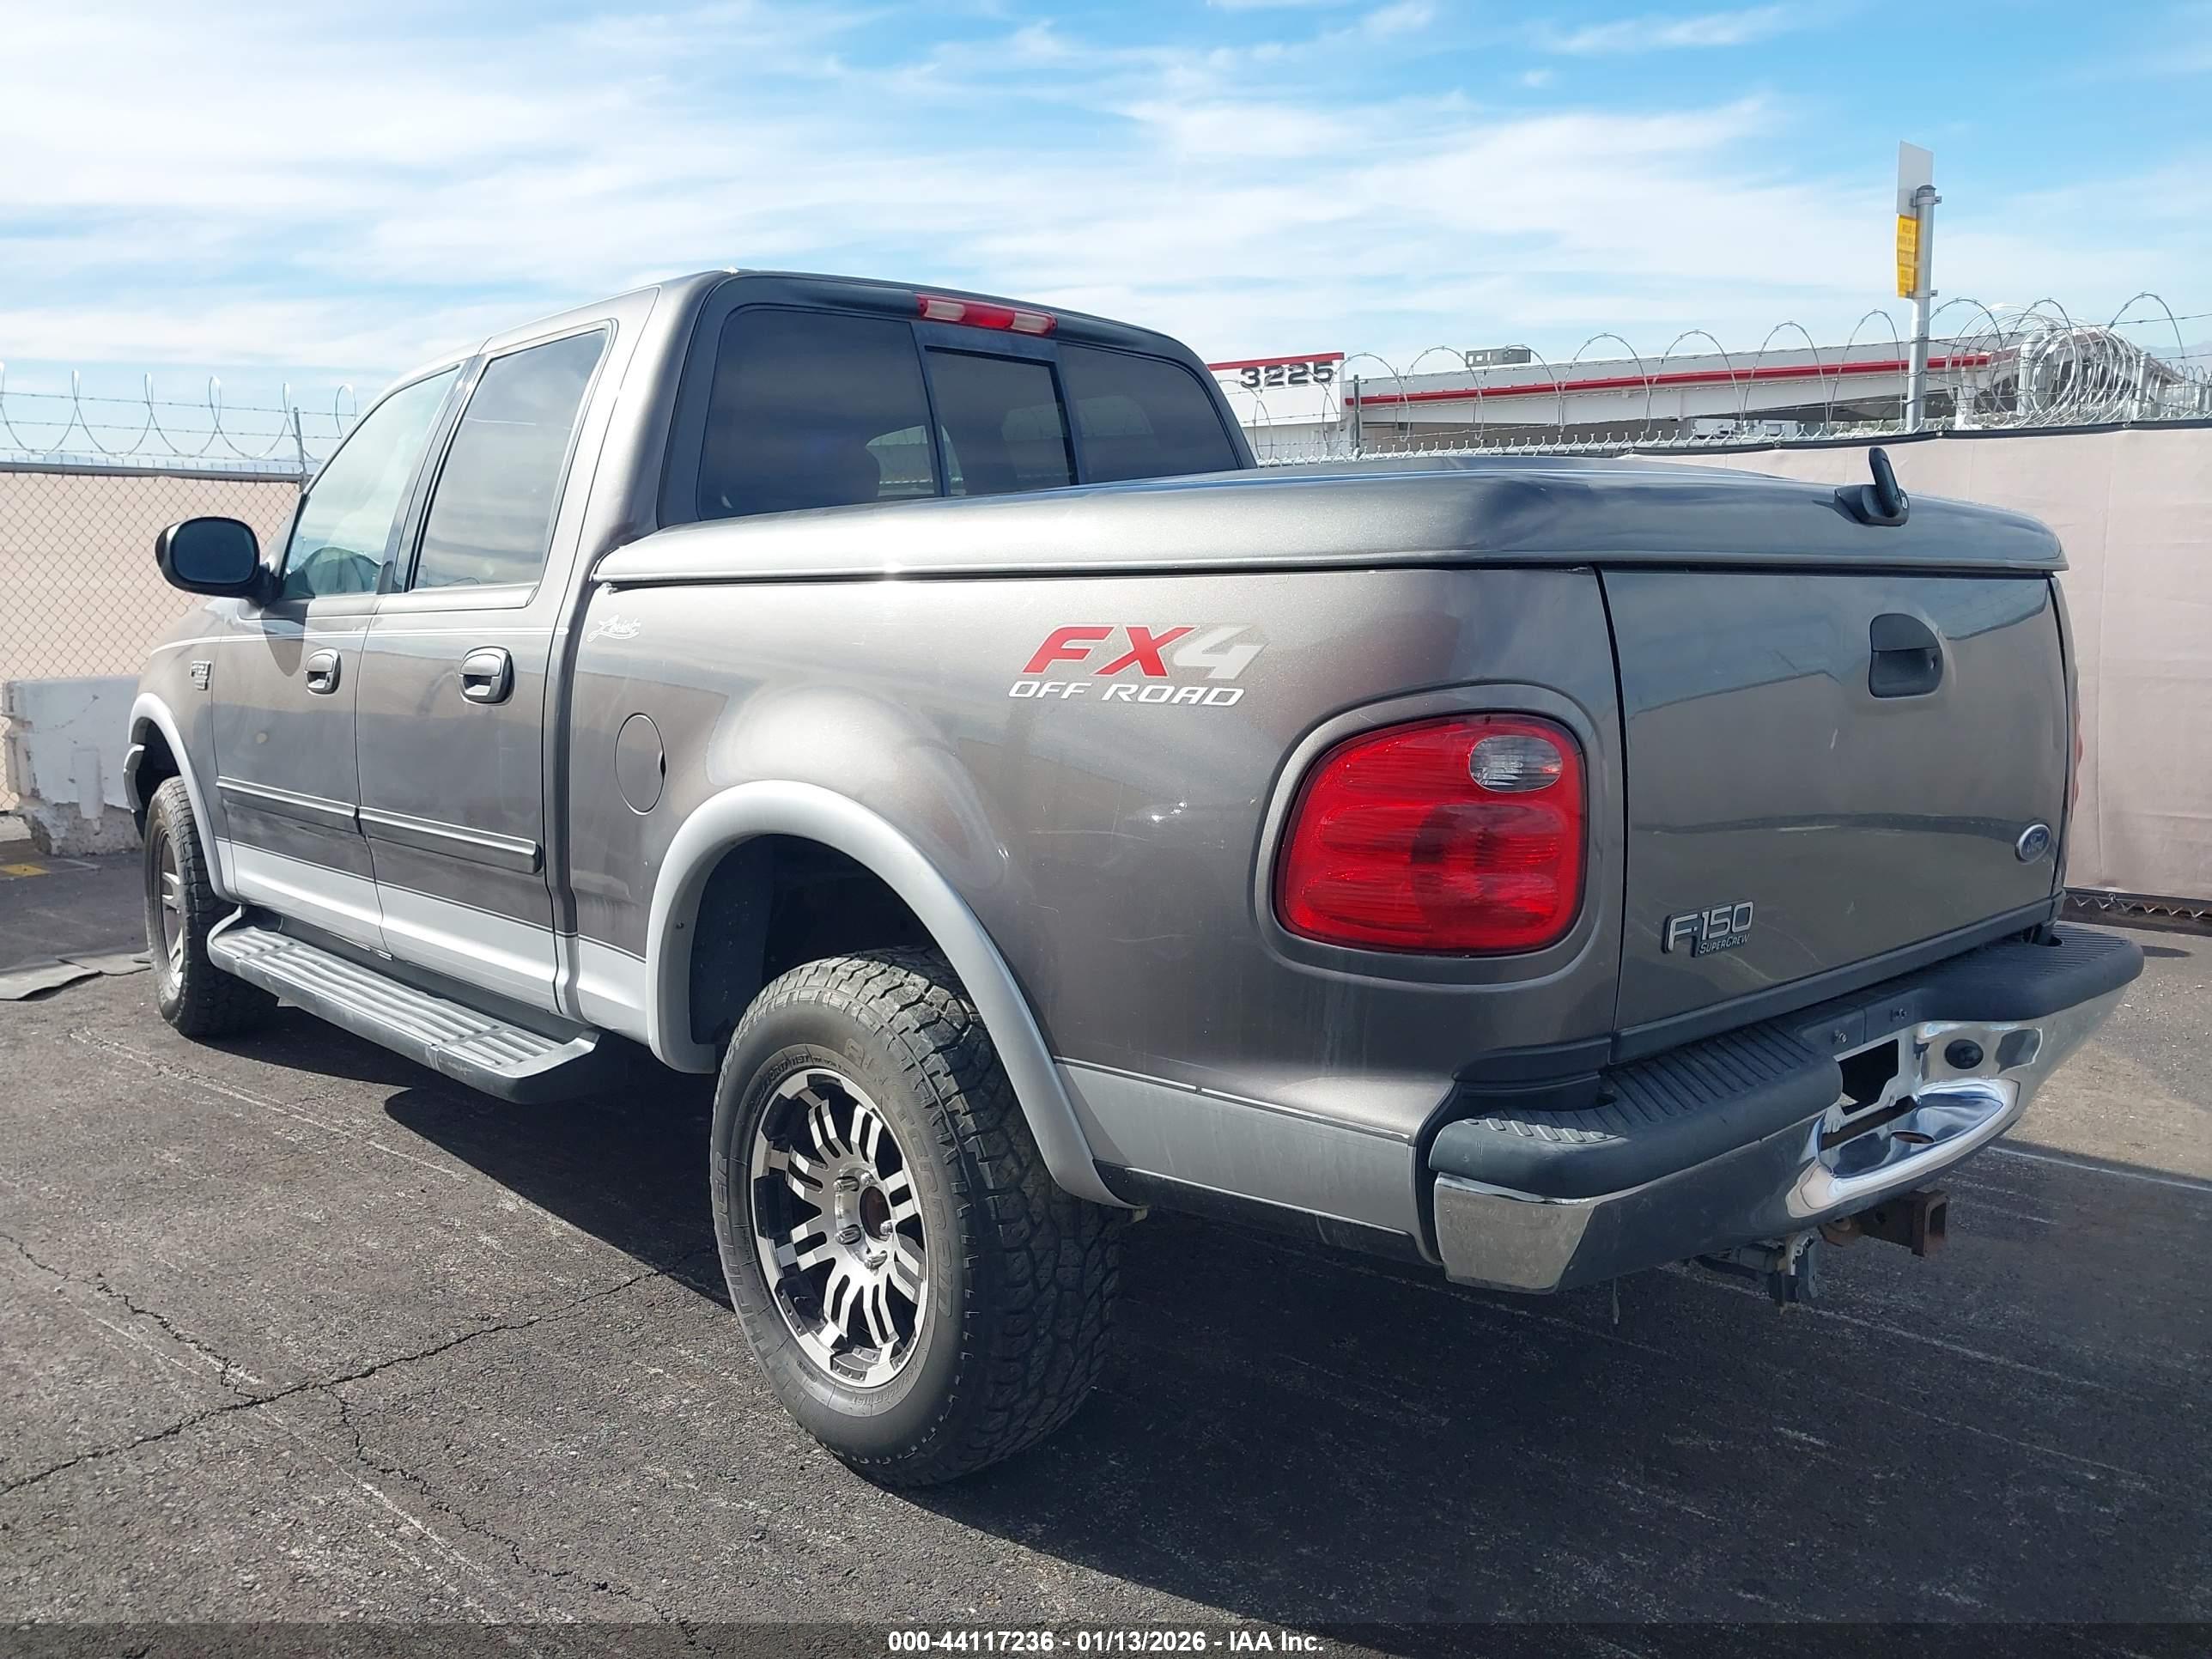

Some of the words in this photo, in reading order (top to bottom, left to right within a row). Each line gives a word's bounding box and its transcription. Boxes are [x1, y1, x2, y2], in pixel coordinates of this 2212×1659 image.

[1240, 362, 1334, 388] 3225
[1019, 623, 1271, 680] FX4
[1007, 679, 1092, 700] OFF
[1101, 683, 1245, 708] ROAD
[1668, 901, 1754, 951] F-150
